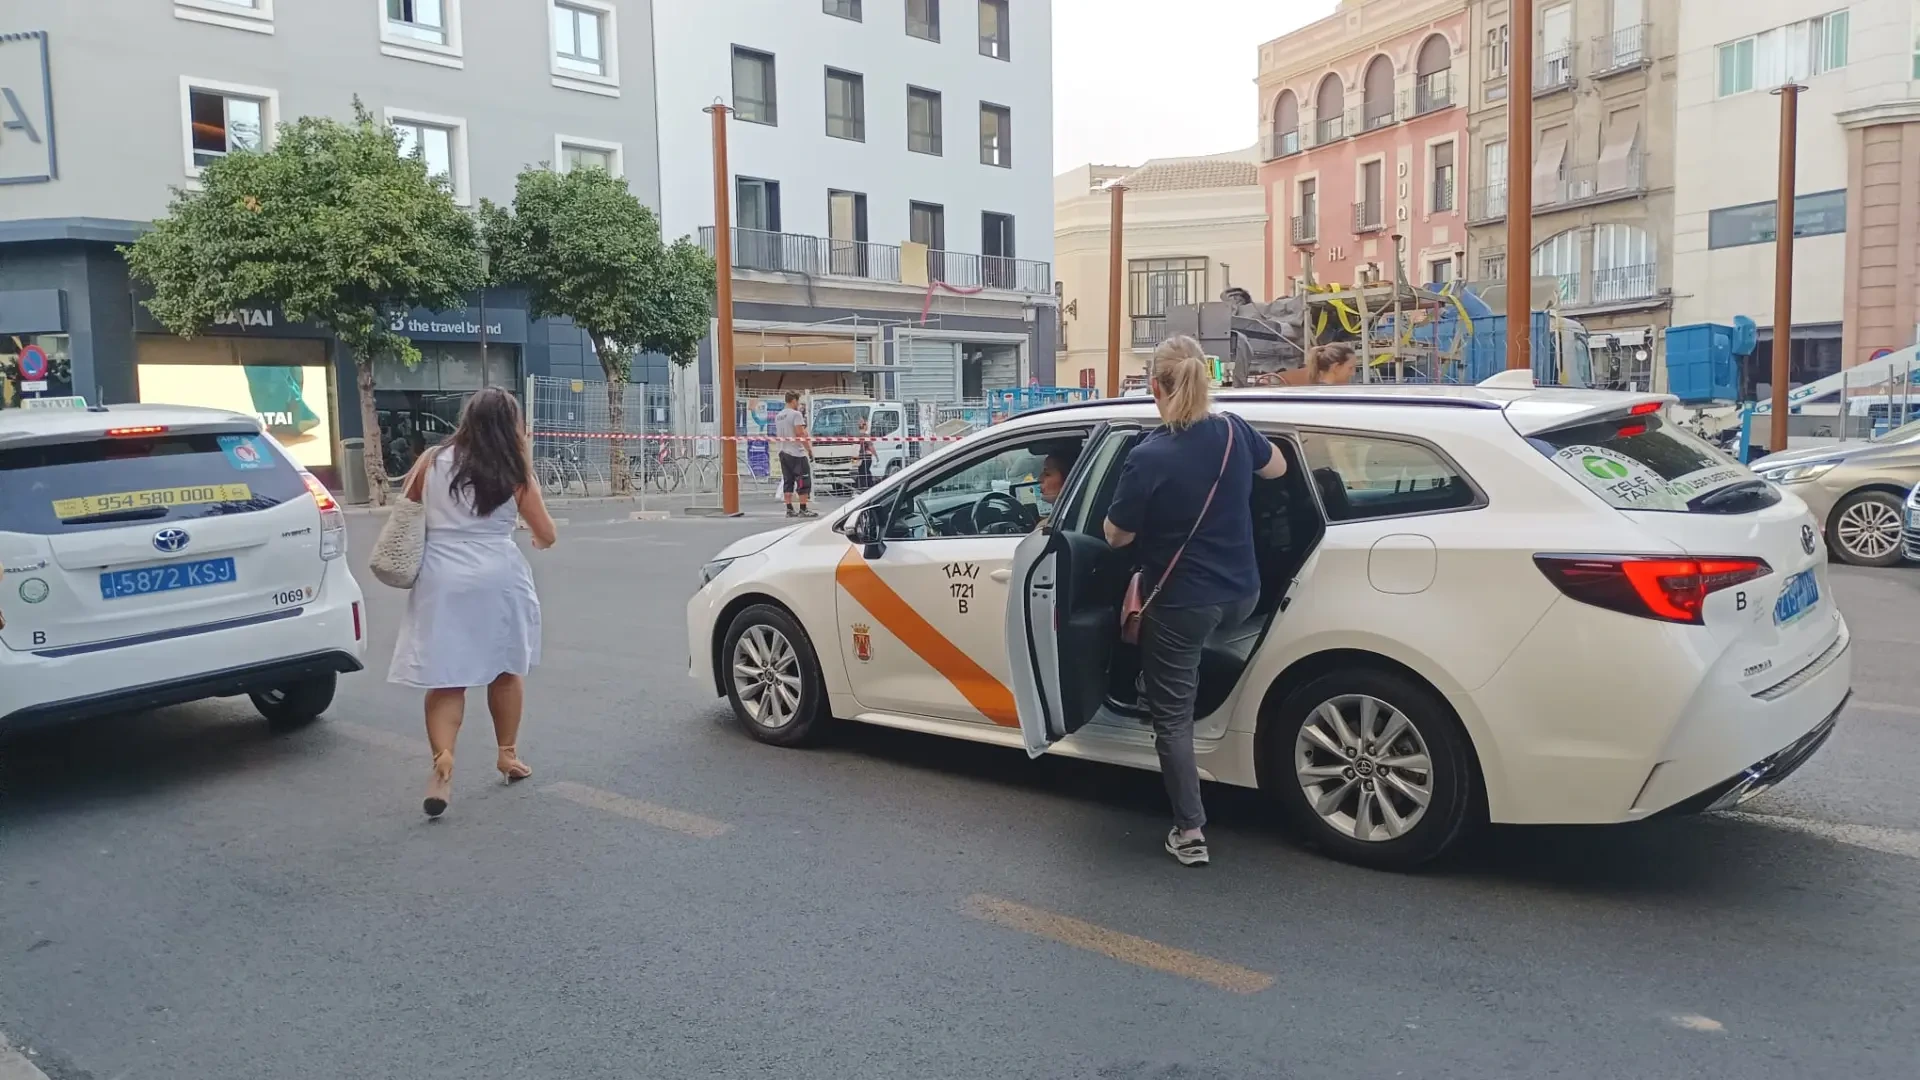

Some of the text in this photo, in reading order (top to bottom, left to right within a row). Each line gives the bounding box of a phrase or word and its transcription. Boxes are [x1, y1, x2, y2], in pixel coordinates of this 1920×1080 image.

[1328, 246, 1346, 262] HL
[408, 319, 429, 332] the
[431, 321, 465, 333] travel
[467, 322, 502, 335] brnd
[1606, 476, 1649, 495] TELE
[1618, 484, 1658, 502] TAXI
[97, 495, 134, 512] 954
[139, 491, 175, 506] 580
[180, 487, 214, 502] 000
[121, 567, 181, 594] 5872
[187, 561, 230, 586] KSJ
[942, 563, 980, 580] TAXI
[272, 588, 304, 606] 1069
[949, 583, 974, 599] 1721
[958, 599, 969, 614] B
[1736, 591, 1747, 611] B
[33, 631, 47, 645] B
